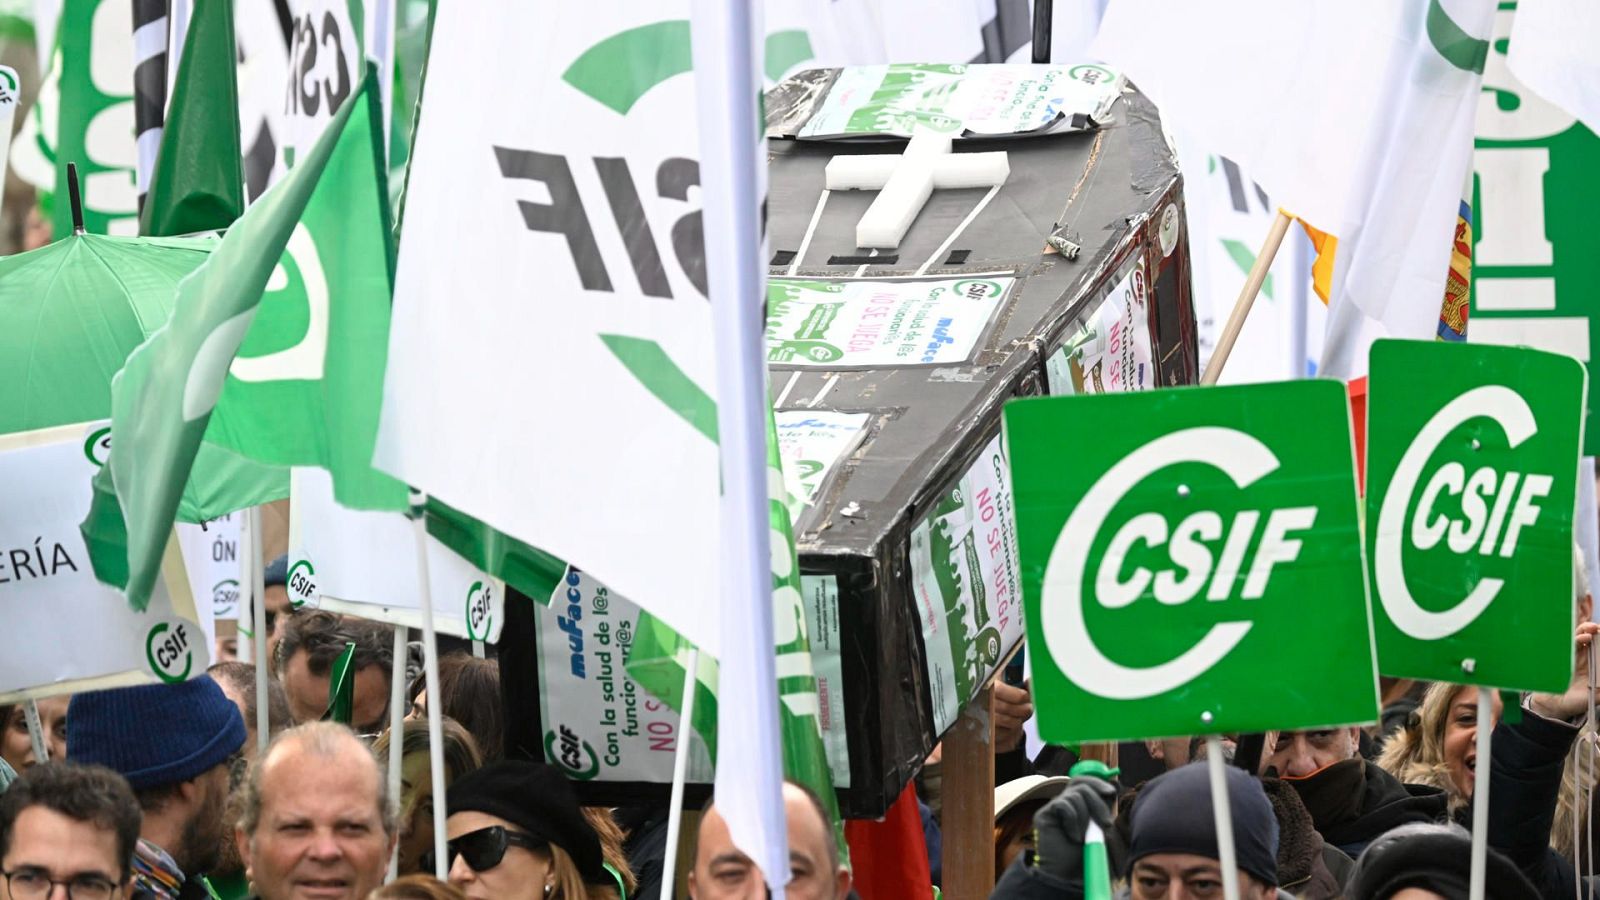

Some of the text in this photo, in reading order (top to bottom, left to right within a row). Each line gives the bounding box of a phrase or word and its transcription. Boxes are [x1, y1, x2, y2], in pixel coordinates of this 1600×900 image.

[1110, 321, 1121, 355] NO
[1121, 325, 1129, 391] funcion
[1129, 351, 1137, 391] salu
[993, 454, 1005, 490] Con
[1411, 462, 1554, 559] CSIF
[0, 536, 78, 583] RÍA
[976, 487, 1009, 634] NO SE JUEGA
[1095, 506, 1318, 609] CSIF
[290, 572, 316, 598] CSIF
[471, 586, 491, 630] CSIF
[157, 624, 188, 669] CSIF
[592, 587, 620, 767] Con la salud de l@s
[615, 620, 639, 738] funciori@s
[560, 724, 581, 770] CSIF
[647, 721, 676, 752] NO
